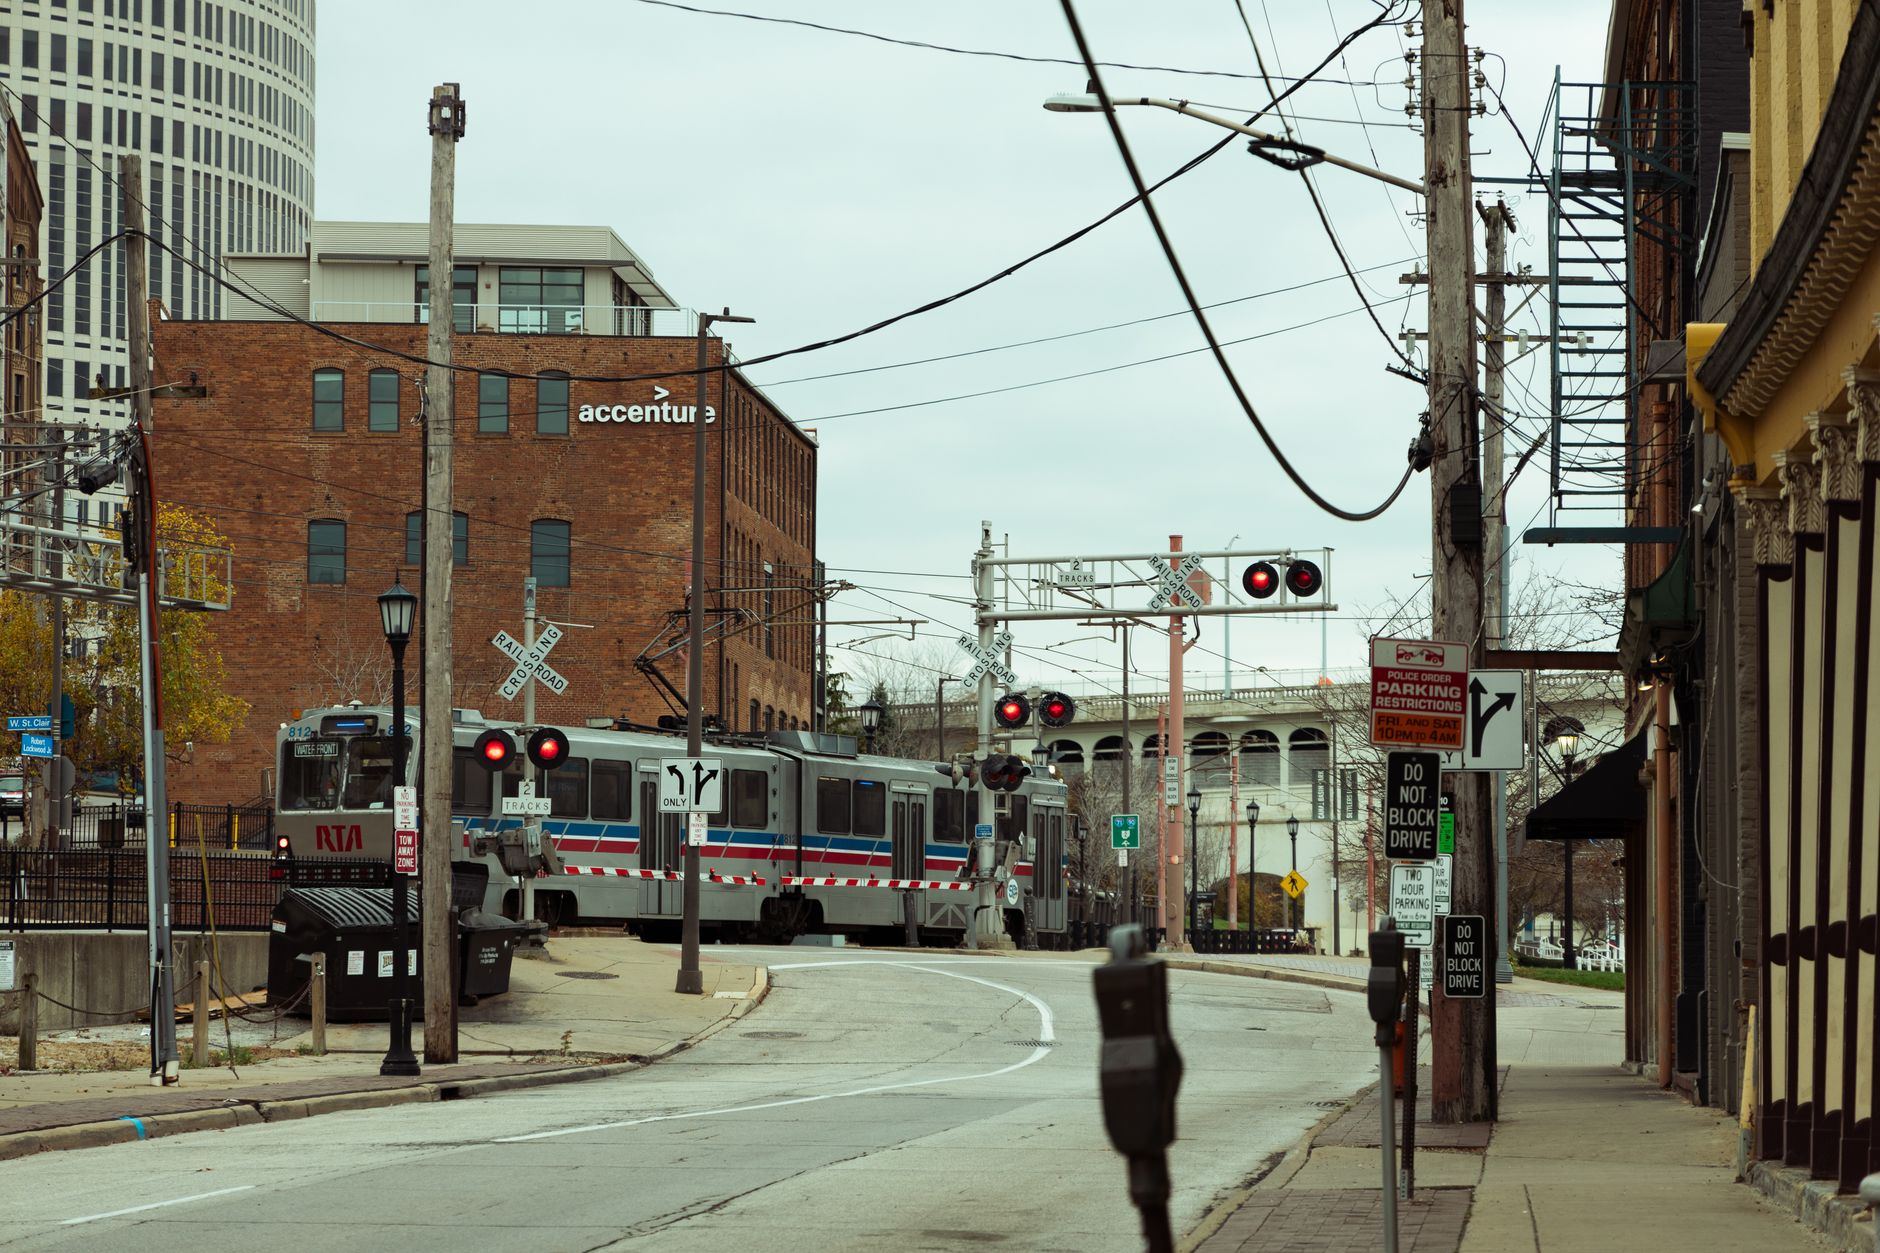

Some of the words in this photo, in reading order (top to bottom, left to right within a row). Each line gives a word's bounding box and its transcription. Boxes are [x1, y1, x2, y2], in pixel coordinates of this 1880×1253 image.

[578, 401, 716, 424] accenture
[1073, 560, 1080, 571] 2
[1060, 574, 1094, 583] TRACKS
[1150, 555, 1200, 610] CROSSING
[503, 628, 559, 697] CROSSING
[963, 632, 1011, 688] CROSSING
[1387, 670, 1419, 681] POLICE
[1420, 673, 1452, 683] ORDER
[1376, 681, 1461, 699] PARKING
[1375, 696, 1463, 712] RESTRICTIONS
[10, 719, 20, 727] W.
[22, 719, 32, 727] St.
[33, 718, 50, 727] Clair
[1377, 716, 1402, 726] FRI.
[1405, 718, 1430, 727] AND
[288, 726, 312, 737] 812
[387, 724, 412, 736] 82
[316, 743, 337, 755] FRONT
[1403, 763, 1424, 782] DO
[400, 792, 409, 800] NO
[523, 784, 531, 796] 2
[1399, 785, 1427, 804] NOT
[505, 801, 549, 811] TRACKS
[663, 798, 687, 807] ONLY
[1388, 807, 1435, 827] BLOCK
[316, 824, 363, 852] RTA
[399, 836, 413, 846] TOW
[1390, 829, 1432, 849] DRIVE
[398, 846, 414, 856] AWAY
[398, 858, 415, 868] ZONE
[1404, 870, 1422, 882] TWO
[1436, 878, 1448, 888] KING
[1400, 884, 1424, 896] HOUR
[1395, 898, 1430, 910] PARKING
[1457, 925, 1472, 939] DO
[1454, 942, 1475, 955] NOT
[1447, 958, 1482, 972] BLOCK
[1448, 974, 1480, 988] DRIVE
